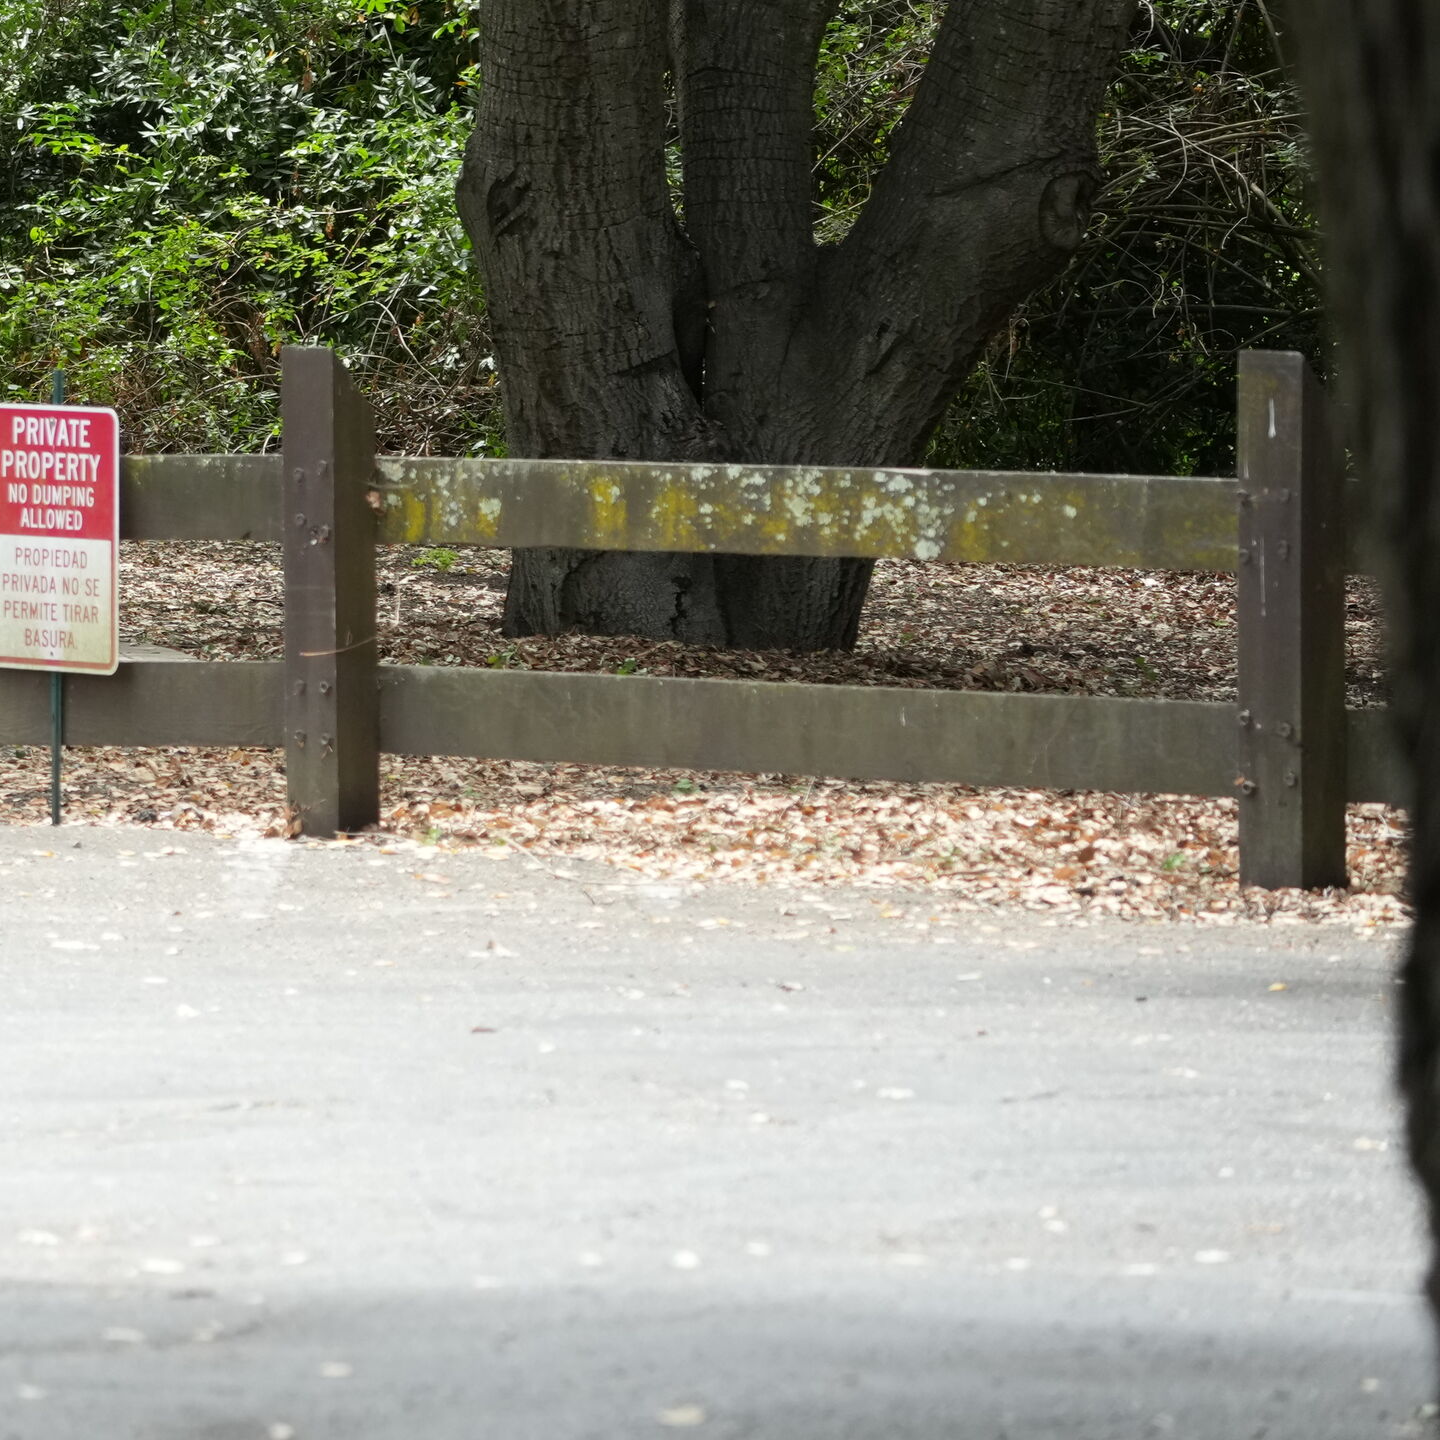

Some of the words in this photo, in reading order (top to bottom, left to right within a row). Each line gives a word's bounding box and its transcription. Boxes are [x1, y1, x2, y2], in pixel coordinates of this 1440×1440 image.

[12, 416, 91, 448] PRIVATE
[0, 450, 101, 482] PROPERTY
[8, 483, 28, 504] NO
[32, 485, 95, 508] DUMPING
[20, 508, 83, 531] ALLOWED
[15, 547, 88, 569] PROPIEDAD
[2, 573, 57, 595] PRIVADA
[62, 576, 80, 596] NO
[85, 578, 101, 597] SE
[3, 600, 58, 623] PERMITE
[63, 603, 99, 624] TIRAR
